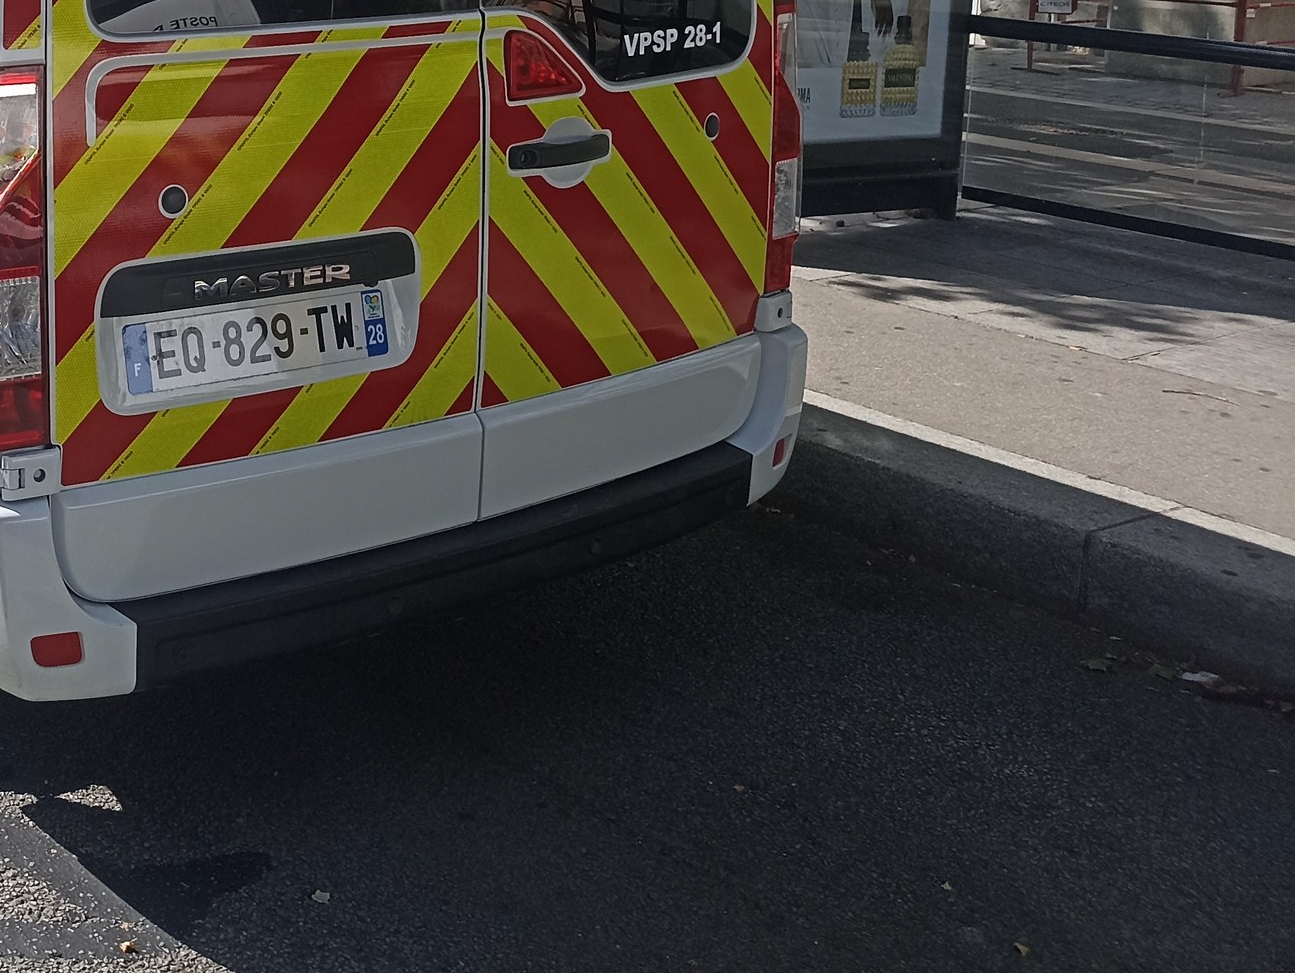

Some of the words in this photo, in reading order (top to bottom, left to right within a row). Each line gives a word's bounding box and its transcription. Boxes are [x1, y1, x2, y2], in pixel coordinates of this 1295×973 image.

[623, 28, 678, 57] VPSP
[683, 21, 721, 49] 28-1
[193, 263, 351, 301] MASTER
[153, 302, 355, 380] EQ-829-TW
[367, 323, 385, 345] 28
[133, 362, 142, 378] F
